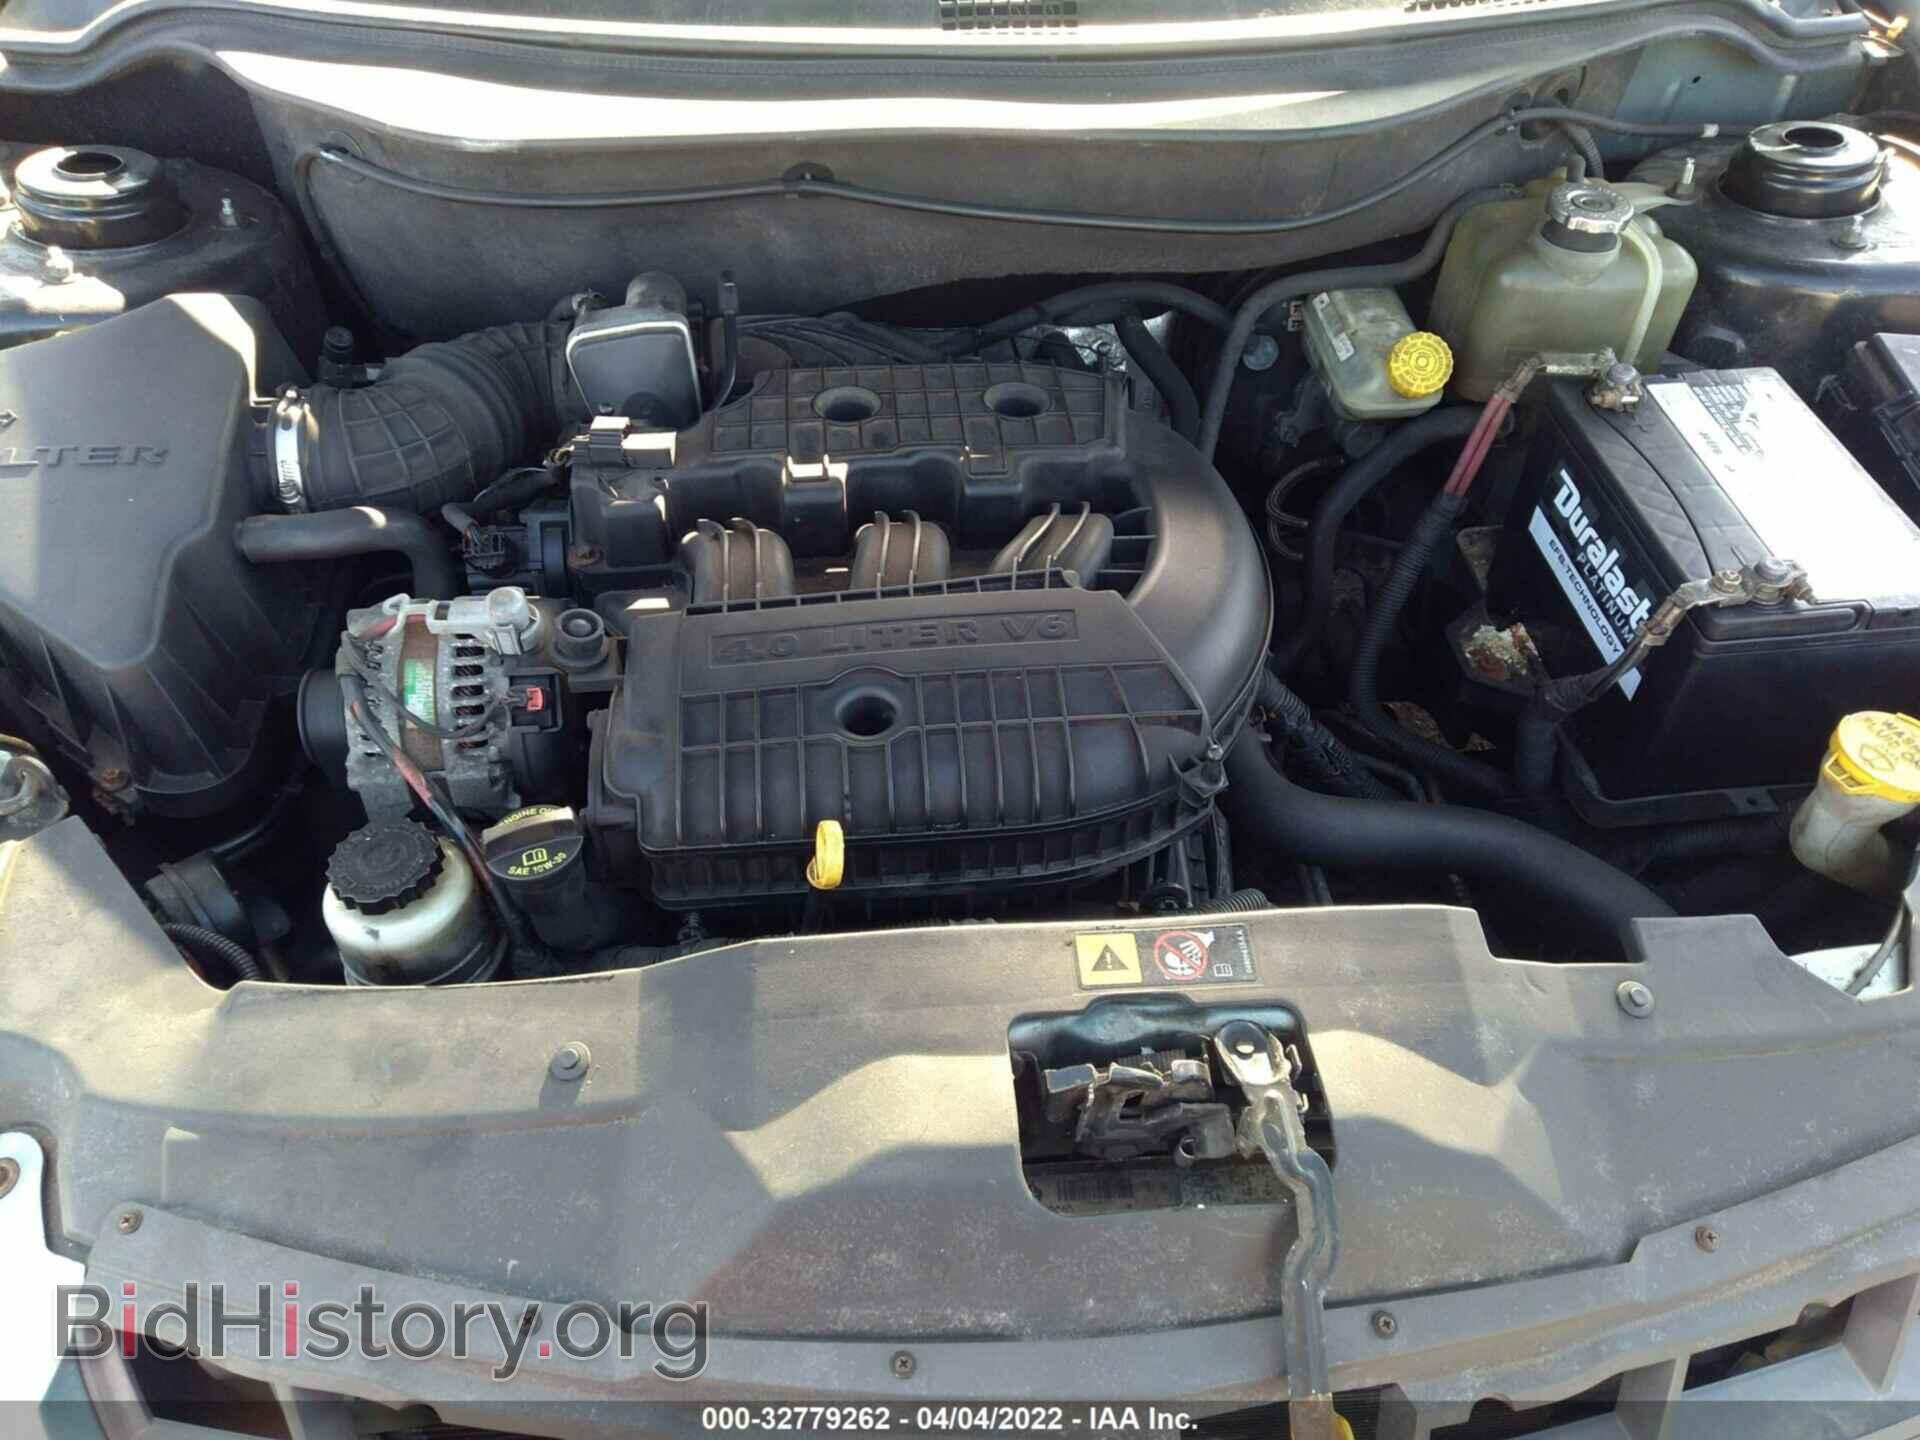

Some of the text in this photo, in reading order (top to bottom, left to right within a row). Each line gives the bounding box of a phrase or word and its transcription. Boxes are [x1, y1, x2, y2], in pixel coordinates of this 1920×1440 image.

[1553, 468, 1652, 629] Duralast
[1576, 552, 1635, 644] PLATINUM
[715, 612, 1070, 662] 4.0 LITER V6
[507, 865, 530, 876] SAE
